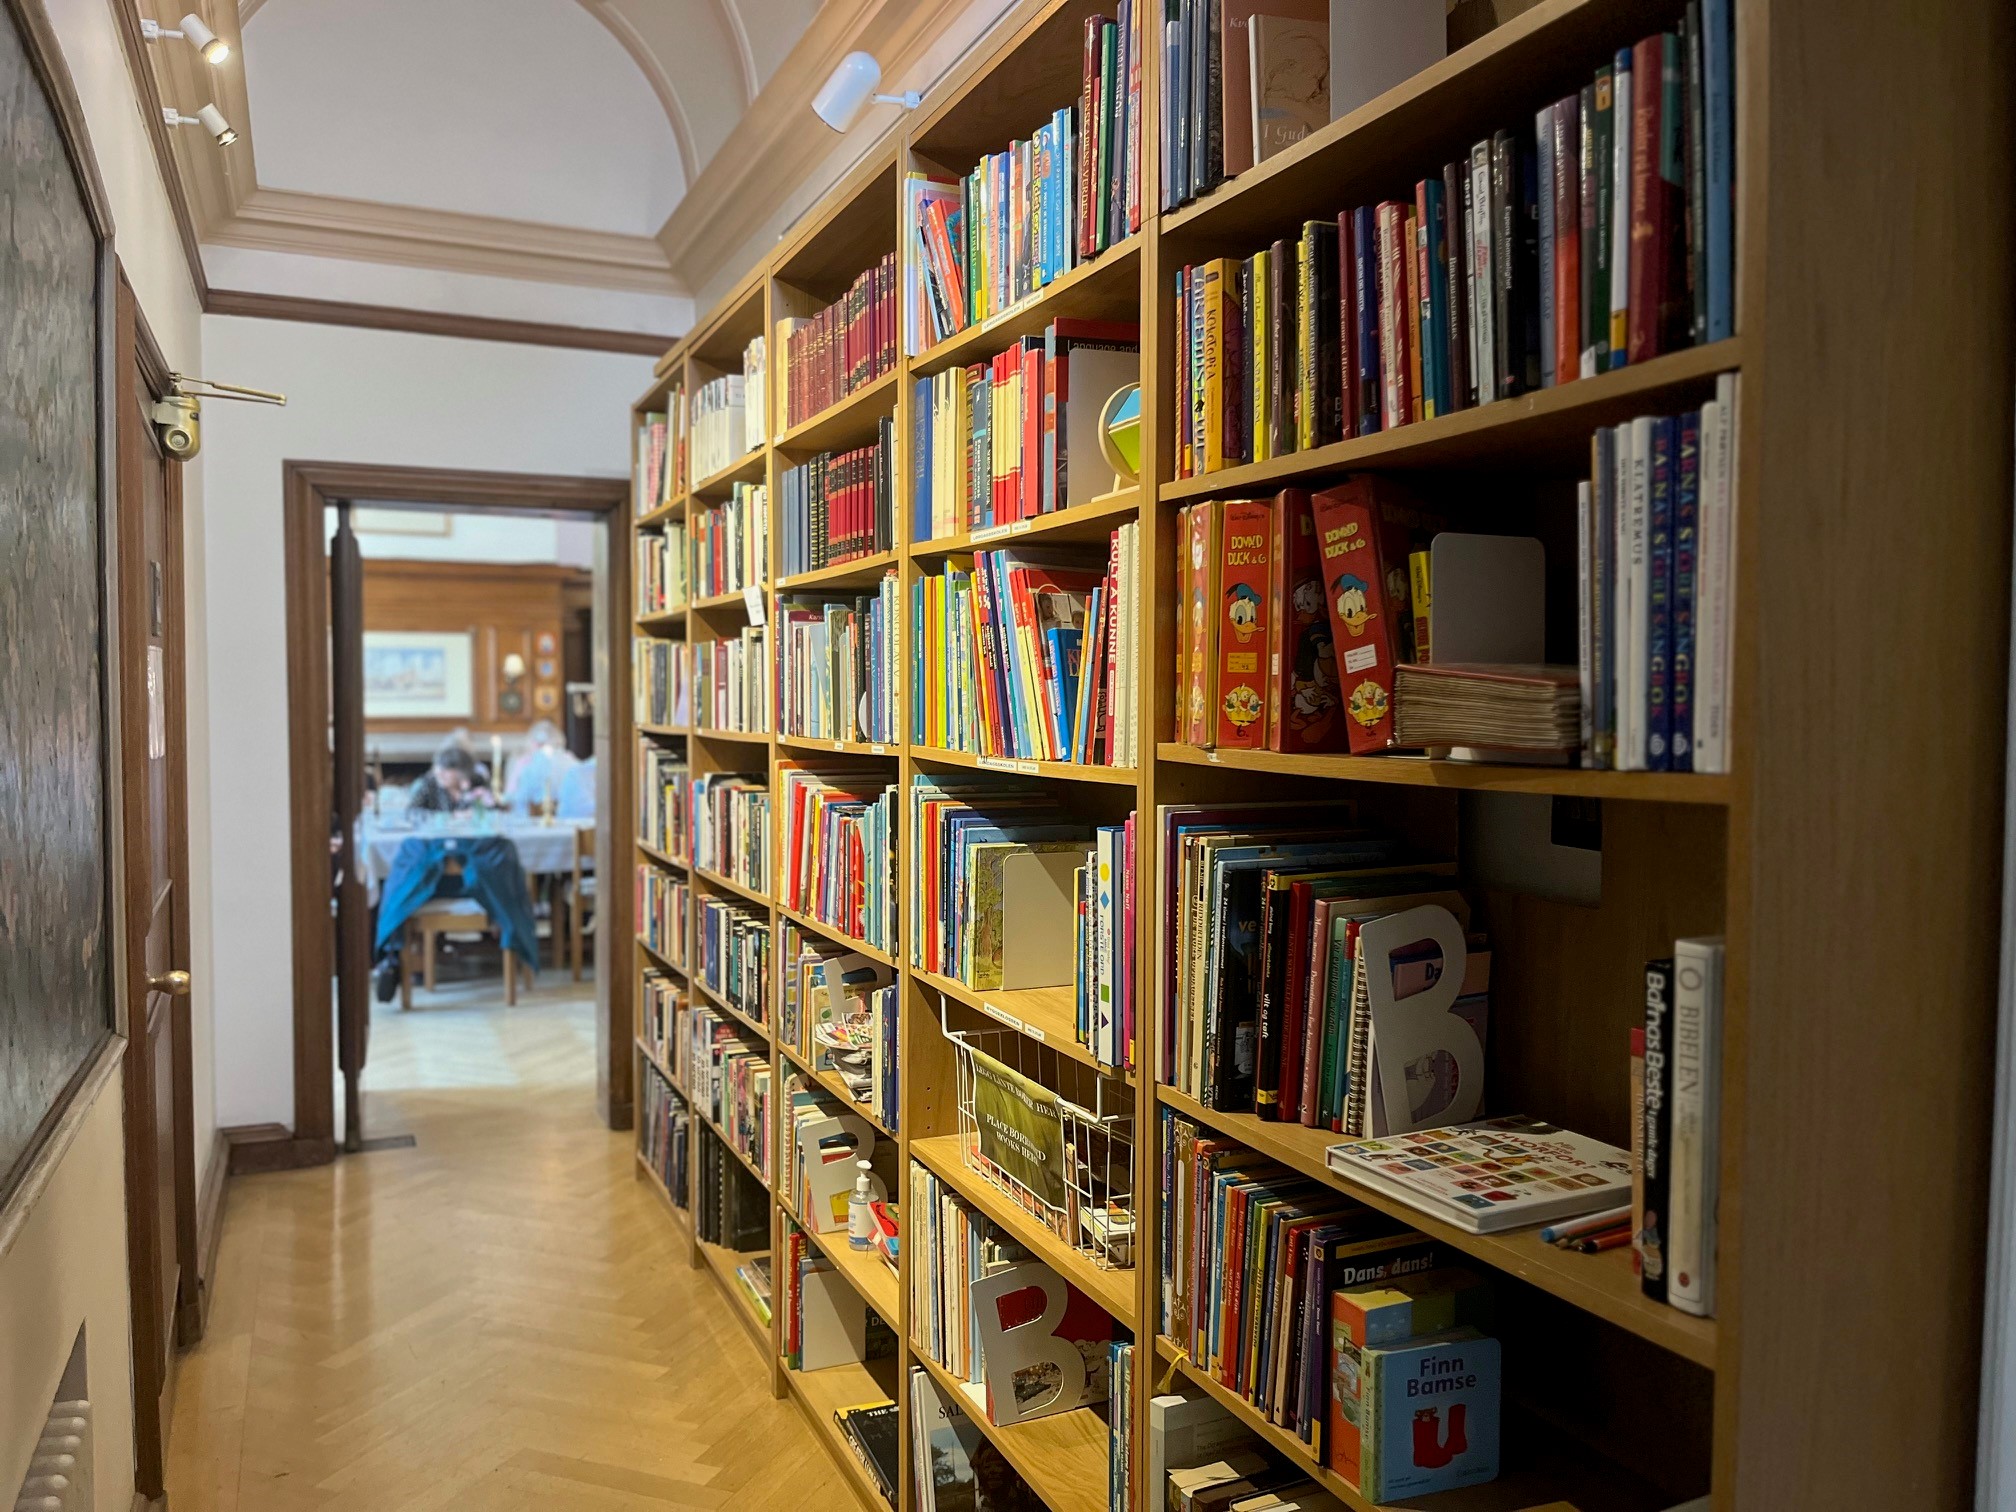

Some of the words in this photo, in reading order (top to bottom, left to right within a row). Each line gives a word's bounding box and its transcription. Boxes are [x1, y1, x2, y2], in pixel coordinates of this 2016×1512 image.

[1081, 172, 1089, 221] VERDEN
[1504, 206, 1512, 236] Espens
[1504, 238, 1513, 290] hemmelighet
[1654, 439, 1667, 526] BARNAS
[1680, 428, 1697, 518] BARNAS
[1632, 458, 1645, 566] KLATREMUS
[1231, 534, 1263, 550] DONALD
[1324, 542, 1350, 560] DUCK
[1325, 522, 1359, 544] DONALD
[1110, 538, 1119, 579] KULT
[1227, 552, 1250, 566] DUCK
[1652, 532, 1667, 604] STORE
[1678, 526, 1695, 599] STORE
[1108, 604, 1117, 664] KUNNE
[1651, 612, 1666, 718] SANGBOK
[1674, 610, 1690, 718] SANGBOK
[1261, 1022, 1269, 1039] tøft
[1678, 1005, 1701, 1095] BIBELEN
[986, 1113, 1010, 1135] PLACE
[996, 1131, 1020, 1153] BOOKS
[1343, 1263, 1388, 1285] Dans,
[1391, 1251, 1434, 1275] dans!
[1419, 1356, 1464, 1378] Finn
[1406, 1374, 1478, 1398] Bamse
[866, 1409, 888, 1418] THE
